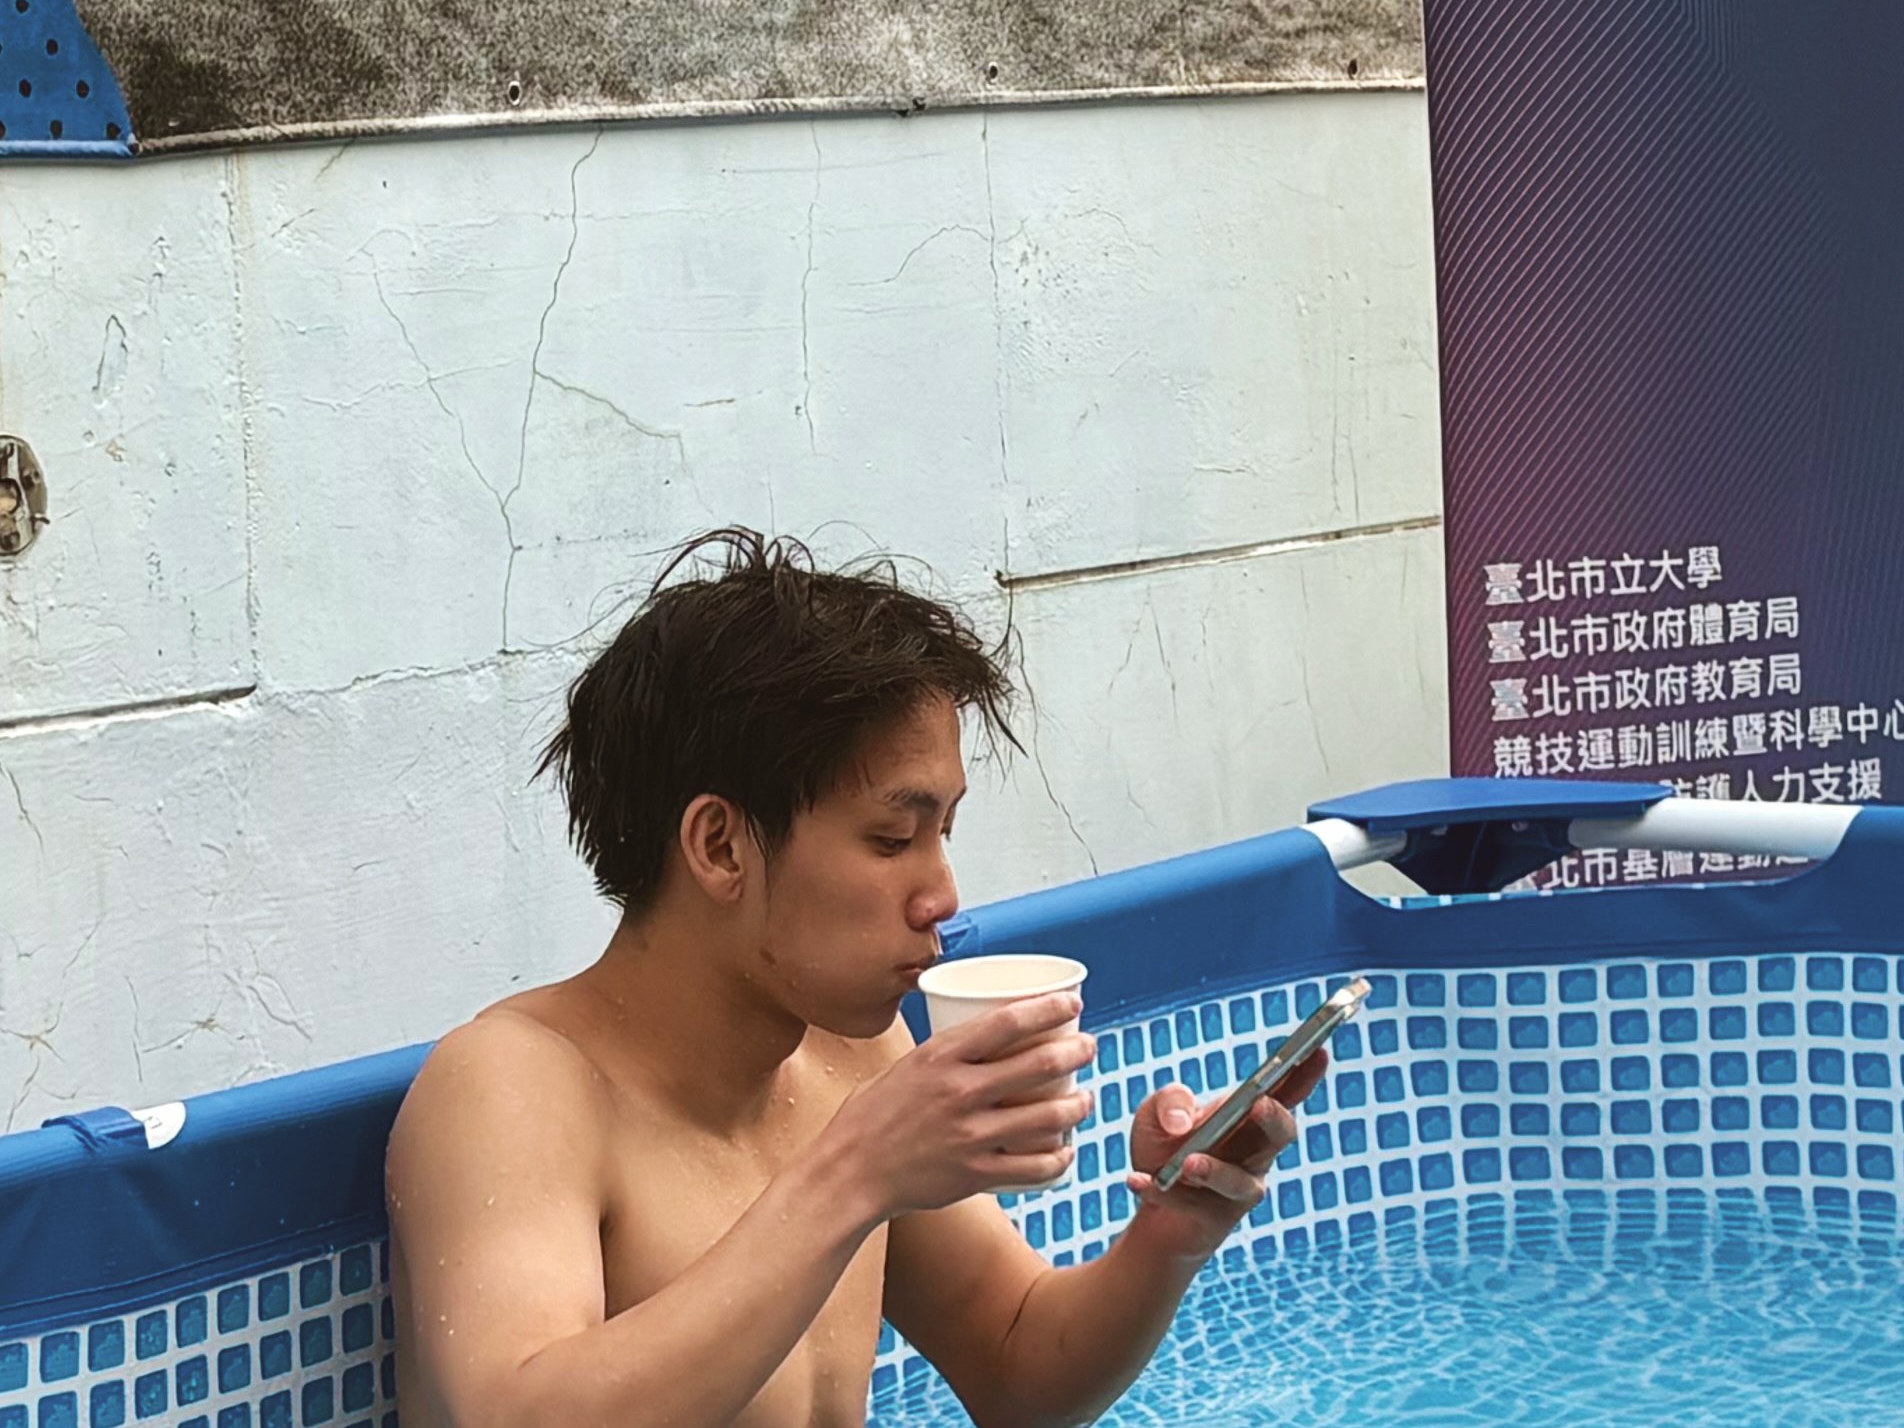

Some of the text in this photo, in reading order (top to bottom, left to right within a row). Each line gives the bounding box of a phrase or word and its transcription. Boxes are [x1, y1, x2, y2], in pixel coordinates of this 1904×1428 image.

[1484, 545, 1722, 606] 臺北市立大學
[1488, 596, 1799, 664] 臺北市政府體育局
[1491, 653, 1802, 722] 臺北市政府教育局
